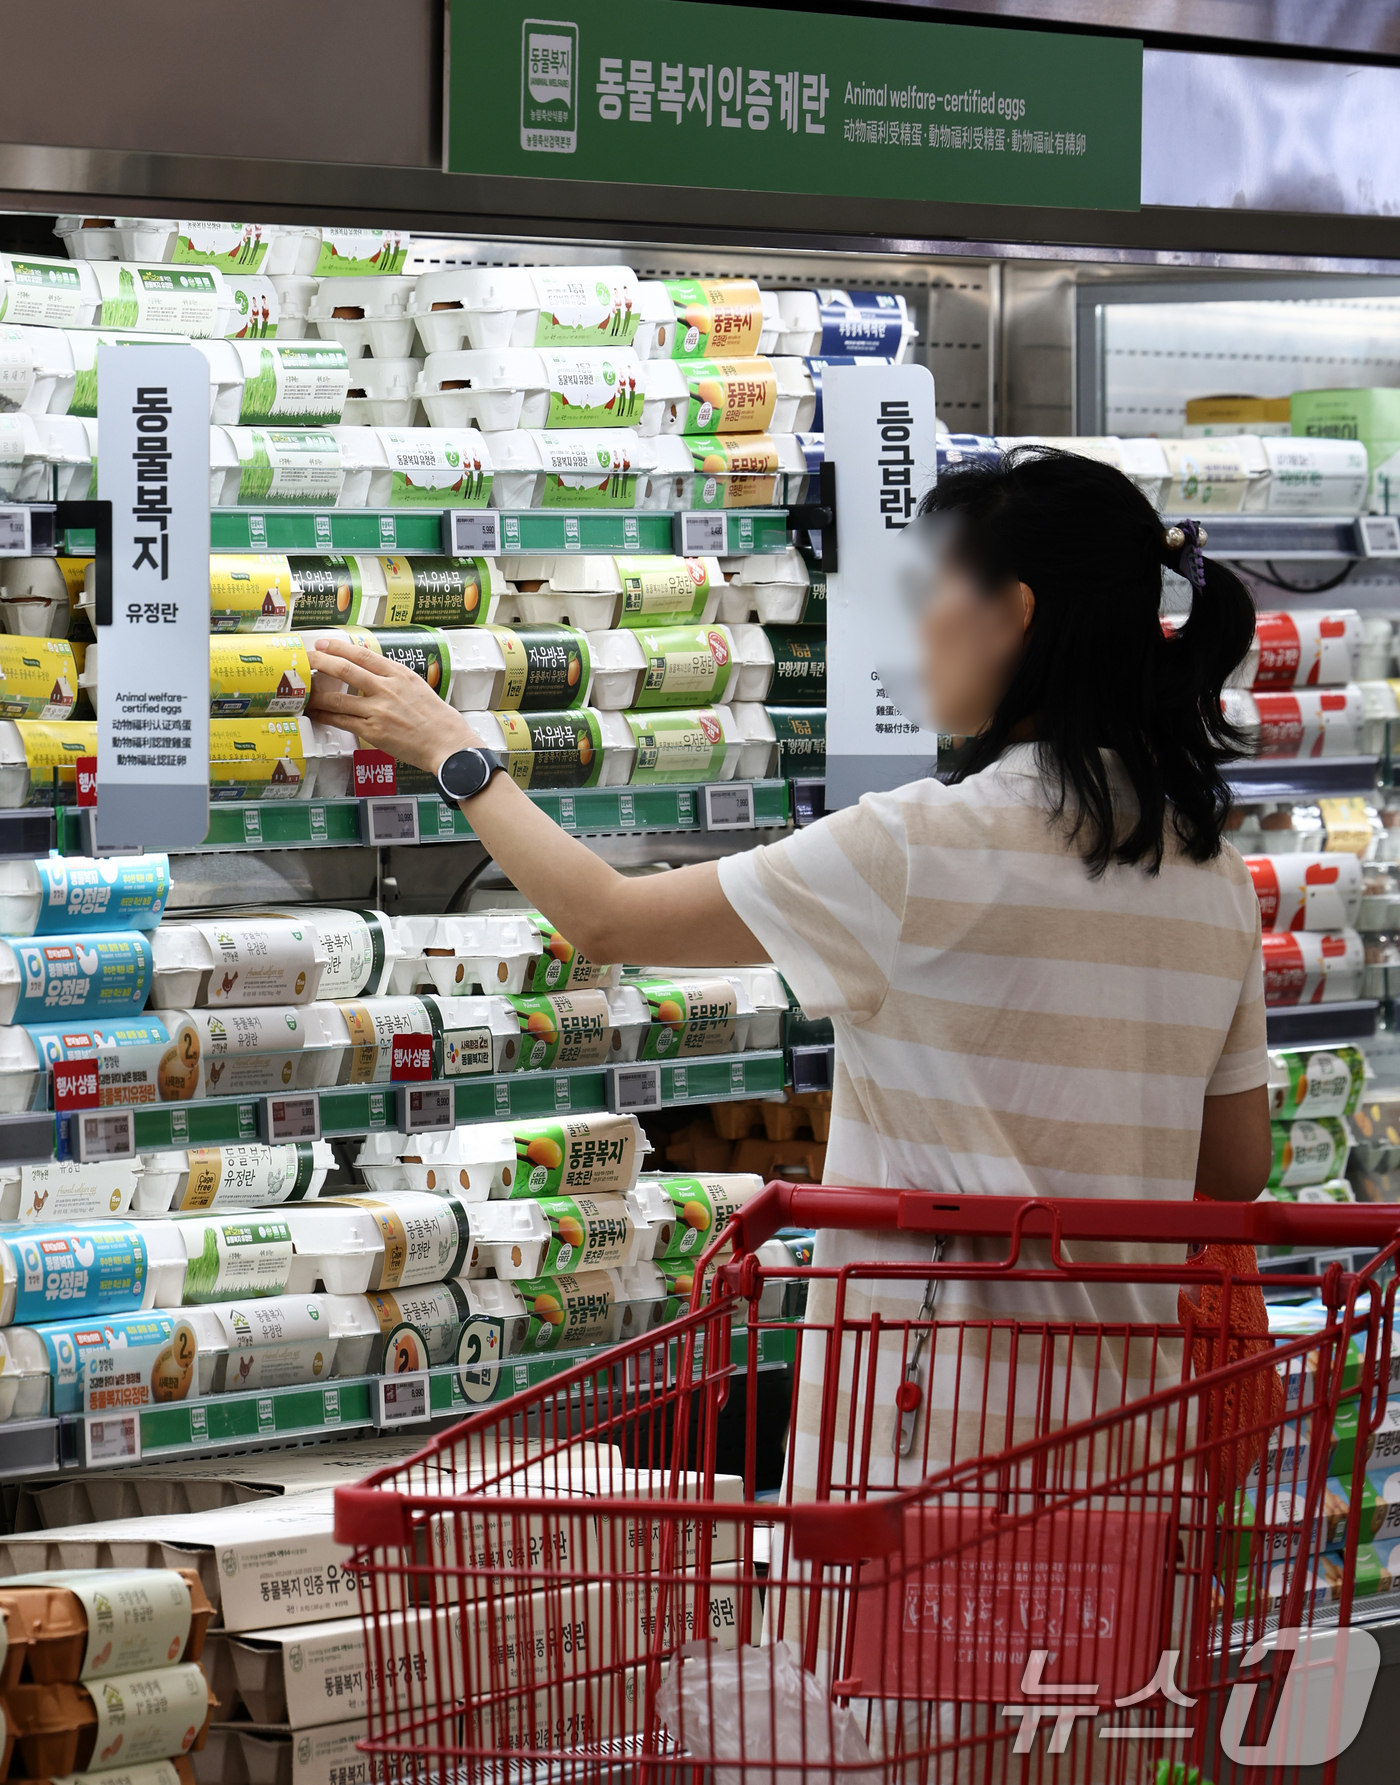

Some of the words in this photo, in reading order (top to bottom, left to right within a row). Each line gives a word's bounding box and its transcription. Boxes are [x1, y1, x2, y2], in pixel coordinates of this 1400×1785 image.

[530, 48, 569, 75] 동물복지
[597, 56, 829, 134] 동물복지인증계란
[844, 81, 888, 107] Animal
[890, 85, 995, 114] welfare-certified
[997, 97, 1026, 121] eggs
[714, 305, 752, 333] 동물복지
[728, 382, 766, 408] 동물복지
[876, 401, 917, 530] 등급란
[131, 387, 173, 581] 동물복지
[293, 570, 336, 592] 자유방목
[418, 571, 463, 593] 자유방목
[669, 575, 692, 595] 유정란
[417, 595, 444, 608] 동물복지
[445, 595, 463, 608] 유정란
[126, 603, 179, 625] 유정란
[528, 646, 567, 668] 자유방목
[692, 656, 716, 675] 유정란
[529, 669, 551, 683] 동물복지
[551, 669, 567, 683] 유정란
[777, 661, 809, 677] 무항생제
[809, 661, 825, 677] 특란
[115, 692, 147, 702] Animal
[148, 692, 188, 702] welfare-
[122, 703, 159, 713] certified
[160, 705, 182, 715] eggs
[533, 726, 576, 747] 자유방목
[356, 764, 394, 784] 행사상품
[67, 886, 111, 915] 유정란
[246, 942, 268, 956] 유정란
[47, 962, 77, 978] 동물복지
[572, 967, 592, 982] 목초란
[45, 978, 90, 1007] 유정란
[232, 1016, 262, 1031] 동물복지
[375, 1014, 413, 1035] 동물복지
[560, 1015, 603, 1046] 동물복지
[237, 1032, 258, 1047] 유정란
[461, 1040, 479, 1050] 사육환경
[393, 1048, 431, 1068] 행사상품
[461, 1052, 489, 1066] 동물복지란
[56, 1074, 97, 1097] 행사상품
[132, 1071, 147, 1082] 청정원
[165, 1076, 186, 1089] 사육환경
[99, 1084, 155, 1106] 동물복지유정란
[225, 1146, 273, 1167] 동물복지
[570, 1139, 624, 1170] 동물복지
[197, 1183, 212, 1192] free
[199, 1175, 214, 1184] Cage
[224, 1169, 256, 1187] 유정란
[530, 1177, 545, 1186] FREE
[566, 1170, 592, 1187] 목초란
[406, 1217, 441, 1240] 동물복지
[589, 1217, 627, 1248] 동물복지
[409, 1241, 431, 1261] 유정란
[558, 1255, 570, 1263] FREE
[45, 1255, 74, 1271] 동물복지
[45, 1270, 89, 1301] 유정란
[254, 1308, 285, 1323] 동물복지
[402, 1299, 440, 1322] 동물복지
[567, 1294, 609, 1326] 동물복지
[262, 1324, 282, 1339] 유정란
[98, 1358, 114, 1372] 청정원
[466, 1334, 491, 1386] 2번
[90, 1377, 105, 1389] 건강한
[125, 1372, 141, 1384] 청정원
[158, 1377, 179, 1389] 사육환경
[89, 1385, 149, 1410] 동물복지유정란
[260, 1577, 302, 1602] 동물복지
[304, 1575, 324, 1596] 인증
[325, 1671, 363, 1698] 동물복지
